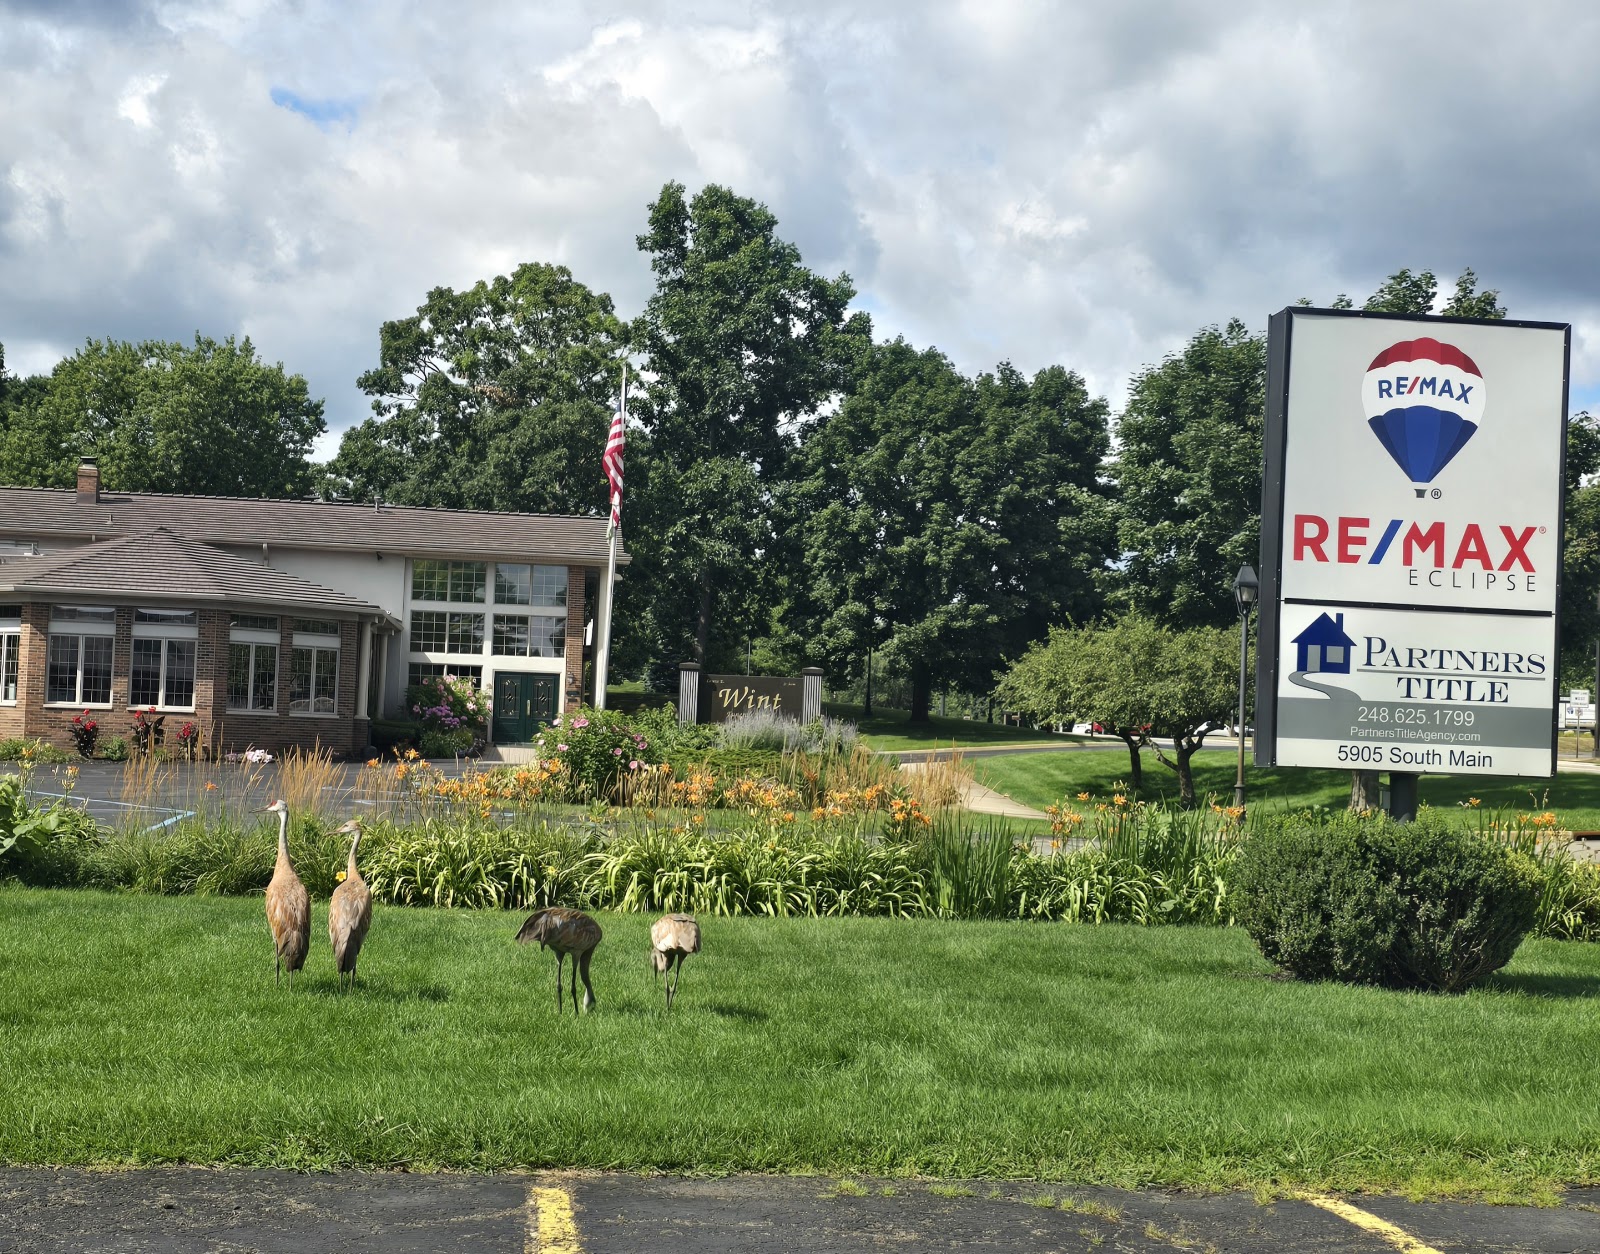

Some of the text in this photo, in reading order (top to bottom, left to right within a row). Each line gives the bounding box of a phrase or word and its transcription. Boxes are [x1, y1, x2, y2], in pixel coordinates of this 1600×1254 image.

[1378, 376, 1474, 405] RE/MAX
[1293, 514, 1537, 573] RE/MAX
[1409, 569, 1536, 592] ECLIPSE
[1362, 636, 1546, 675] PARTNERS
[718, 686, 782, 710] Wint
[1397, 677, 1509, 703] TITLE
[1357, 706, 1475, 726] 248.625.1799
[1350, 726, 1480, 742] PartnersTitleAgency.com
[1337, 745, 1493, 768] 5905 South Main
